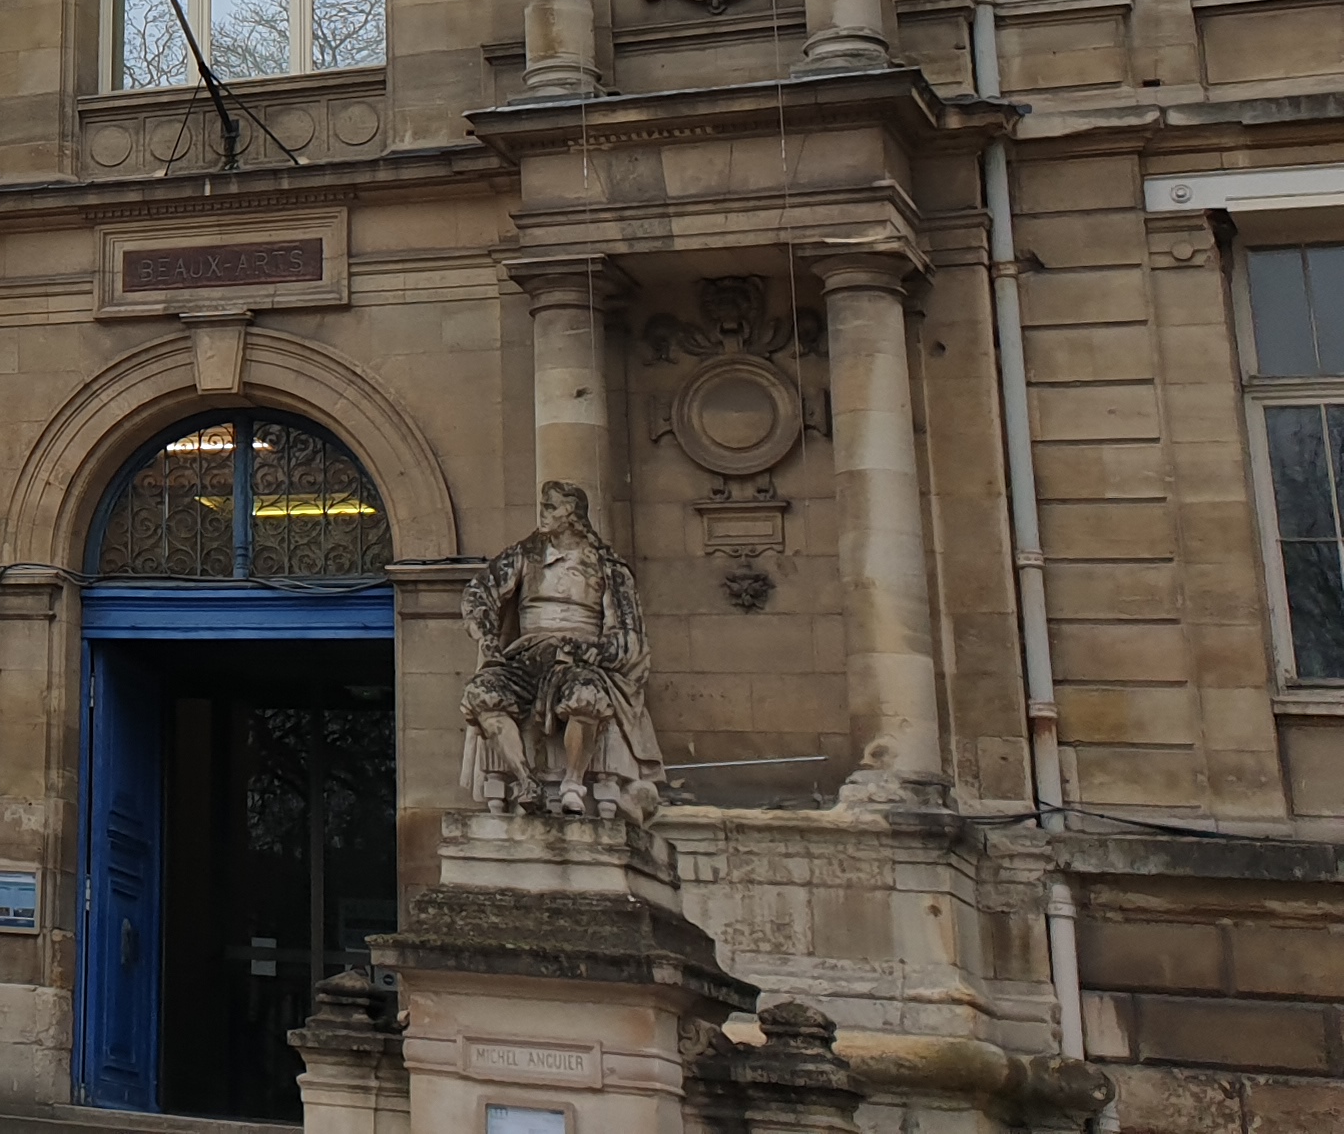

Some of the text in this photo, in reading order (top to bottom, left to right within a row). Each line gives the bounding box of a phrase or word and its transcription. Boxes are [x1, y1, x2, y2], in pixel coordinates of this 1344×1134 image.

[139, 249, 305, 282] BEAUX-ARTS
[475, 1047, 585, 1072] MICHEL ANGUIER
